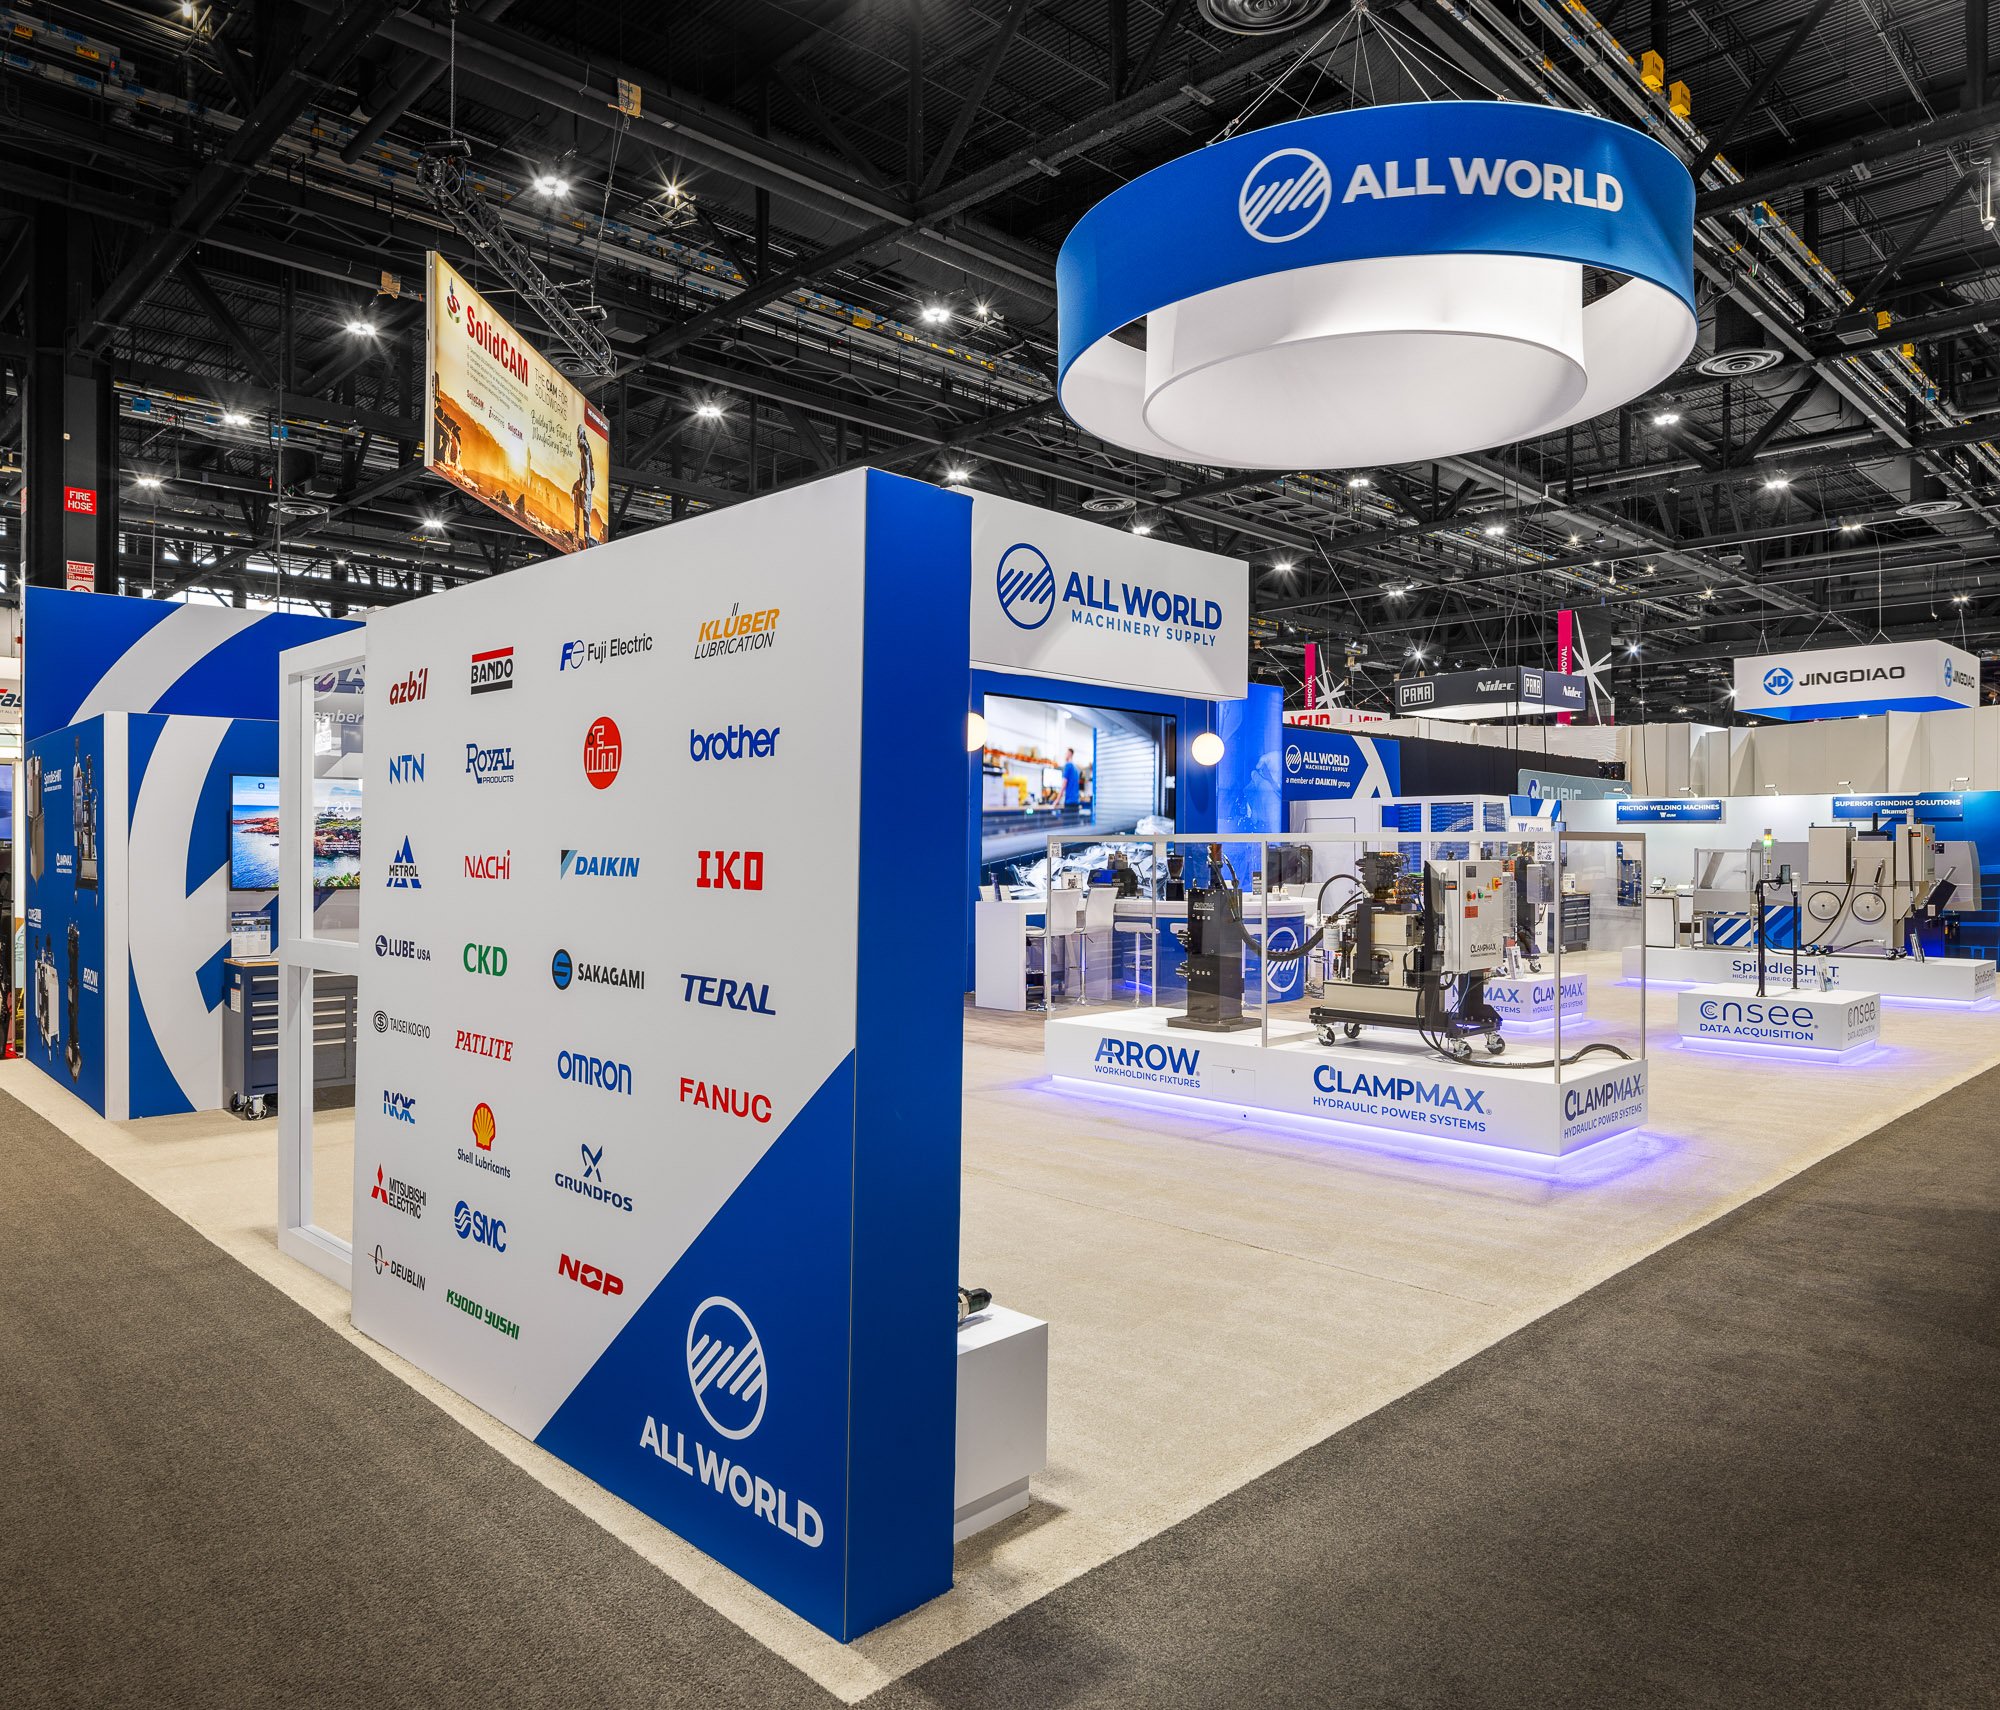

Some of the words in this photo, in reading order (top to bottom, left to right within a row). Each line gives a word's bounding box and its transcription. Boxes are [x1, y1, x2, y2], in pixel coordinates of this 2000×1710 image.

[1341, 157, 1446, 204] ALL
[1448, 156, 1624, 213] WORLD
[466, 305, 528, 388] SolidCAM
[535, 383, 568, 421] SOLIDWORKS
[546, 379, 558, 398] CAM
[68, 500, 93, 512] HOSE
[70, 490, 91, 502] FIRE
[1062, 571, 1119, 613] ALL
[1122, 583, 1222, 631] WORLD
[1071, 609, 1160, 638] MACHINERY
[1166, 627, 1217, 647] SUPPLY
[587, 641, 607, 664] Fuji
[610, 632, 653, 658] Electric
[694, 631, 775, 660] LUBRICATION
[389, 667, 429, 705] azbil
[470, 658, 513, 684] BANDO
[1798, 666, 1906, 687] JINGDIAO
[1952, 670, 1975, 689] JINGDIAO
[1403, 686, 1431, 703] PAMA
[1476, 679, 1516, 693] Nidec
[1525, 677, 1541, 695] PAMA
[1562, 685, 1583, 699] Nidec
[314, 709, 362, 723] ember
[586, 725, 619, 774] ifm
[690, 724, 780, 762] brother
[389, 753, 425, 785] NTN
[1302, 751, 1319, 765] ALL
[1319, 752, 1350, 767] WORLD
[1305, 764, 1331, 772] MACHINERY
[482, 775, 514, 784] PRODUCTS
[1290, 777, 1308, 785] member
[1308, 777, 1315, 785] of
[1315, 777, 1338, 787] DAIKIN
[1338, 780, 1351, 789] group
[1874, 799, 1914, 807] GRINDING
[388, 864, 419, 878] METROL
[574, 856, 640, 878] DAIKIN
[696, 850, 764, 891] IKO
[388, 938, 415, 959] LUBE
[416, 948, 431, 961] USA
[463, 942, 508, 977] CKD
[577, 962, 645, 990] SAKAGAMI
[680, 973, 776, 1016] TERAL
[455, 1030, 514, 1062] PATLITE
[1699, 1024, 1730, 1034] DATA
[1734, 1026, 1814, 1041] ACQUISITION
[1856, 1026, 1876, 1039] ACQUISITION
[1094, 1037, 1200, 1076] ARROW
[557, 1050, 632, 1095] OMRON
[1094, 1065, 1158, 1082] WORKHOLDING
[1159, 1075, 1201, 1088] FIXTURES
[384, 1089, 416, 1124] NOK
[680, 1077, 772, 1123] FANUC
[1564, 1073, 1642, 1121] CLAMPMAX
[1313, 1096, 1378, 1115] HYDRAULIC
[1381, 1106, 1426, 1122] POWER
[1429, 1113, 1486, 1132] SYSTEMS
[1564, 1118, 1597, 1139] HYDRAULIC
[1598, 1111, 1619, 1127] POWER
[1619, 1102, 1643, 1120] SYSTEMS
[457, 1148, 474, 1165] Shell
[475, 1154, 511, 1179] Lubricants
[388, 1192, 422, 1220] ELECTRIC
[389, 1176, 427, 1206] MITSUBISHI
[554, 1173, 633, 1212] GRUNDFOS
[472, 1210, 507, 1253] SMC
[390, 1260, 426, 1291] DEUBLIN
[558, 1253, 624, 1296] NOP
[446, 1289, 483, 1320] KYODO
[484, 1308, 520, 1340] YUSHI
[639, 1415, 694, 1476] ALL
[695, 1441, 824, 1548] WORLD
